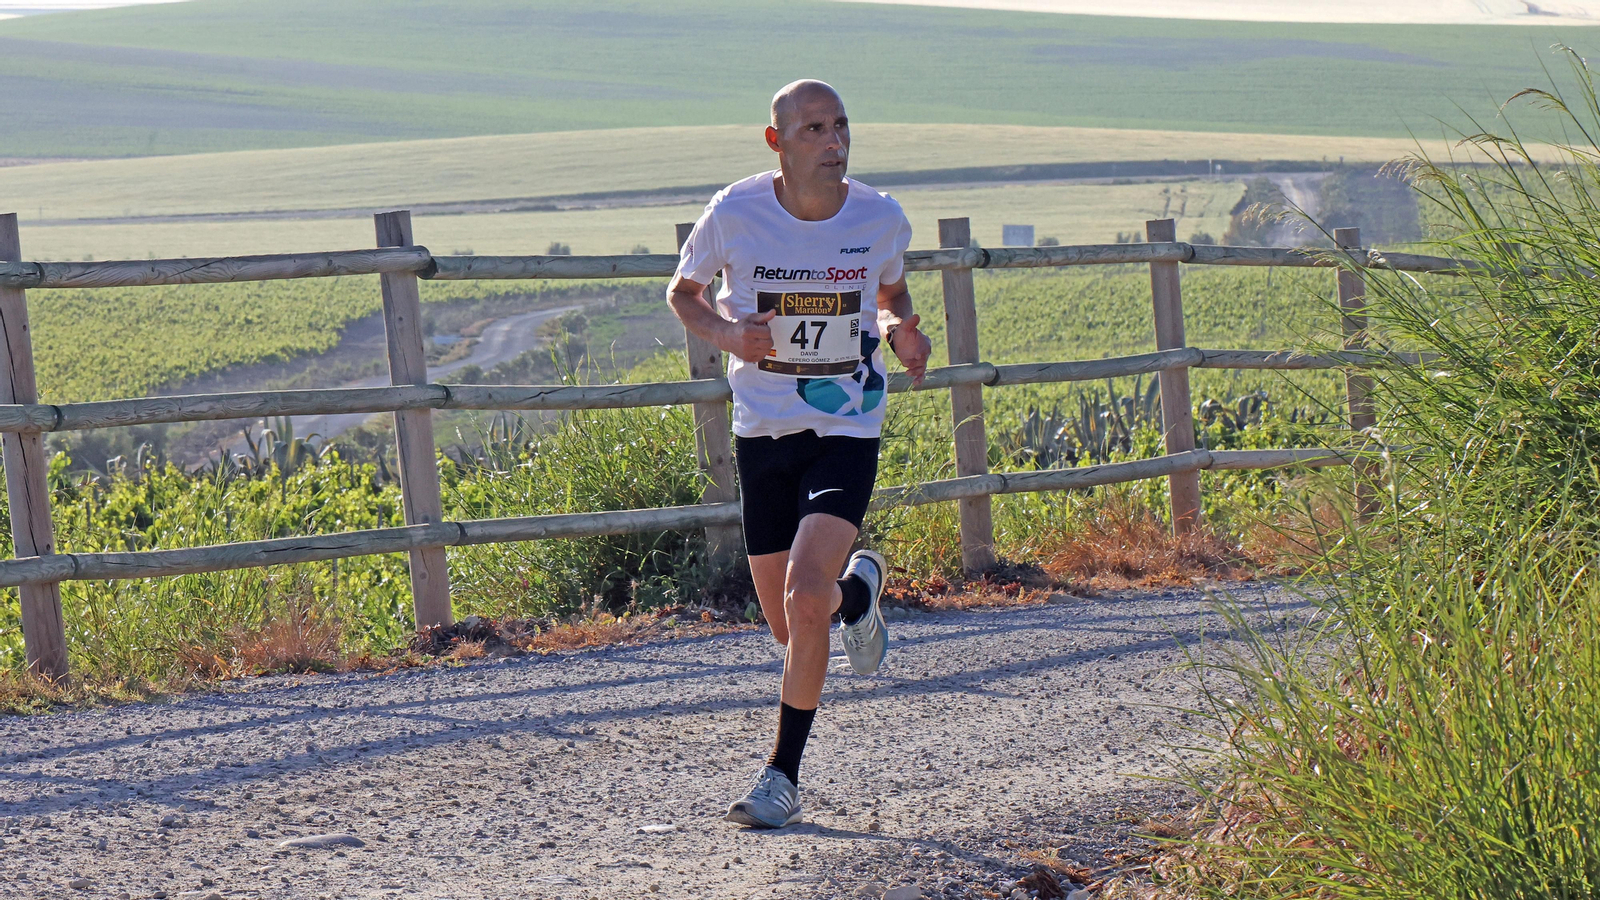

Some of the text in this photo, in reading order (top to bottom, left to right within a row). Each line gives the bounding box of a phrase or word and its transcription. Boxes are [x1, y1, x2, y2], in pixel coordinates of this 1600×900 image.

[786, 293, 836, 312] Sherry
[794, 304, 829, 314] Maratón
[790, 320, 828, 350] 47
